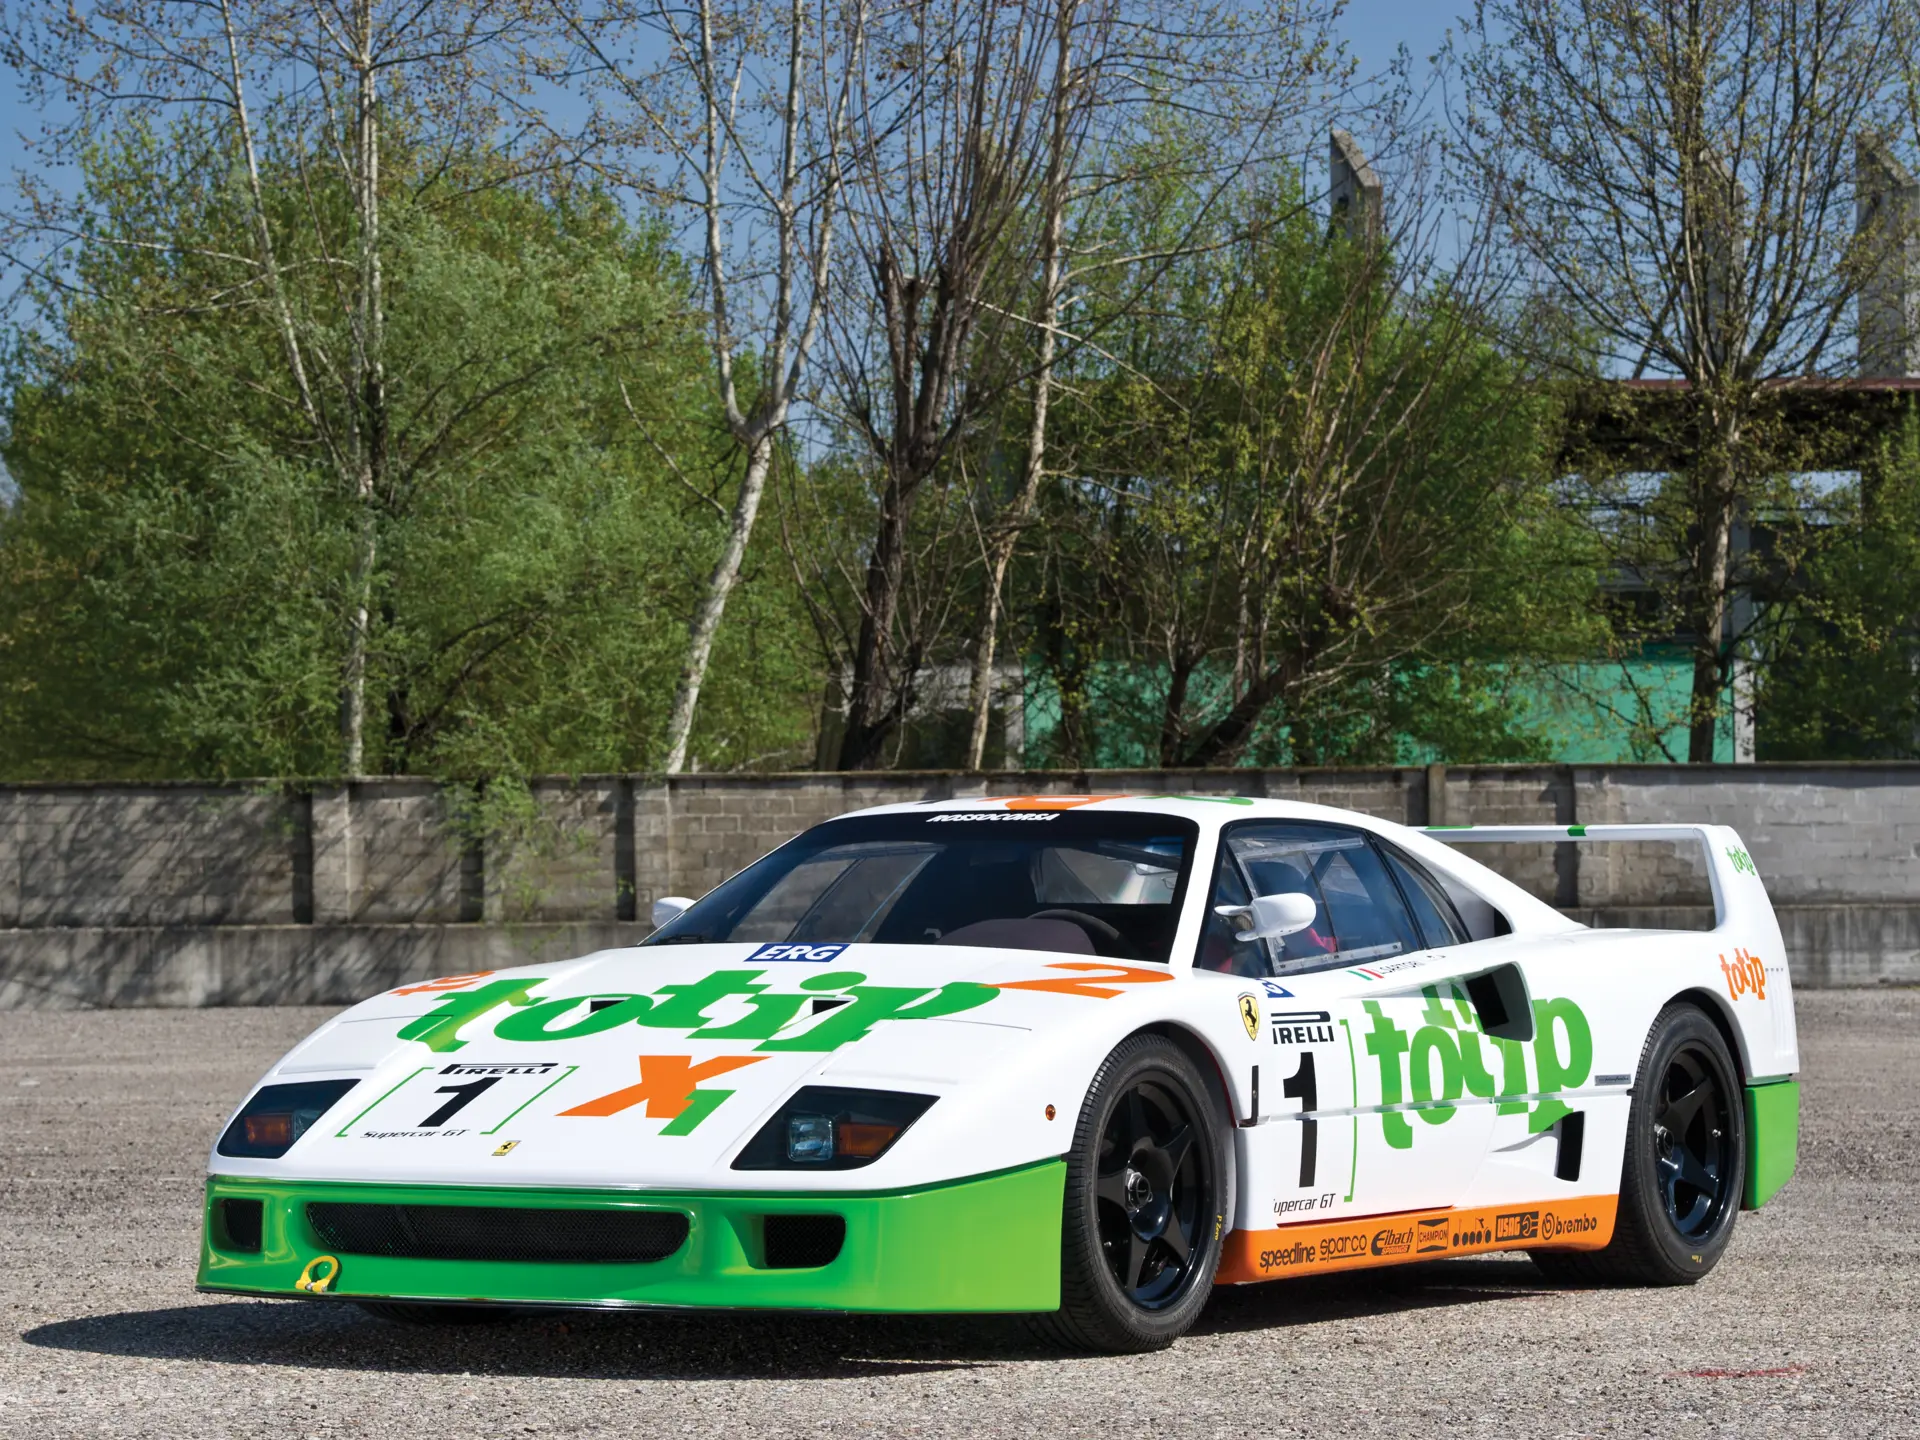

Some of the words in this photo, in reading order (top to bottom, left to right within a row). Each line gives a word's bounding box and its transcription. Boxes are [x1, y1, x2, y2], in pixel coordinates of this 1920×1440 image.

[1725, 845, 1755, 876] totip
[751, 945, 843, 961] ERG
[1719, 948, 1766, 1001] totip
[396, 970, 1001, 1052] totip
[438, 1062, 559, 1075] PIRELLI
[1361, 983, 1593, 1150] totip
[417, 1076, 503, 1128] 1
[1283, 1051, 1318, 1188] 1
[360, 1130, 440, 1140] Supercar
[442, 1128, 470, 1138] GT
[1273, 1198, 1318, 1217] upercar
[1320, 1193, 1337, 1209] GT
[1418, 1228, 1448, 1244] CHAMPION
[1496, 1216, 1521, 1239] USAG
[1555, 1213, 1598, 1235] brembo
[1320, 1234, 1368, 1262] sparco
[1371, 1228, 1414, 1256] Eibach
[1259, 1242, 1316, 1273] speedline
